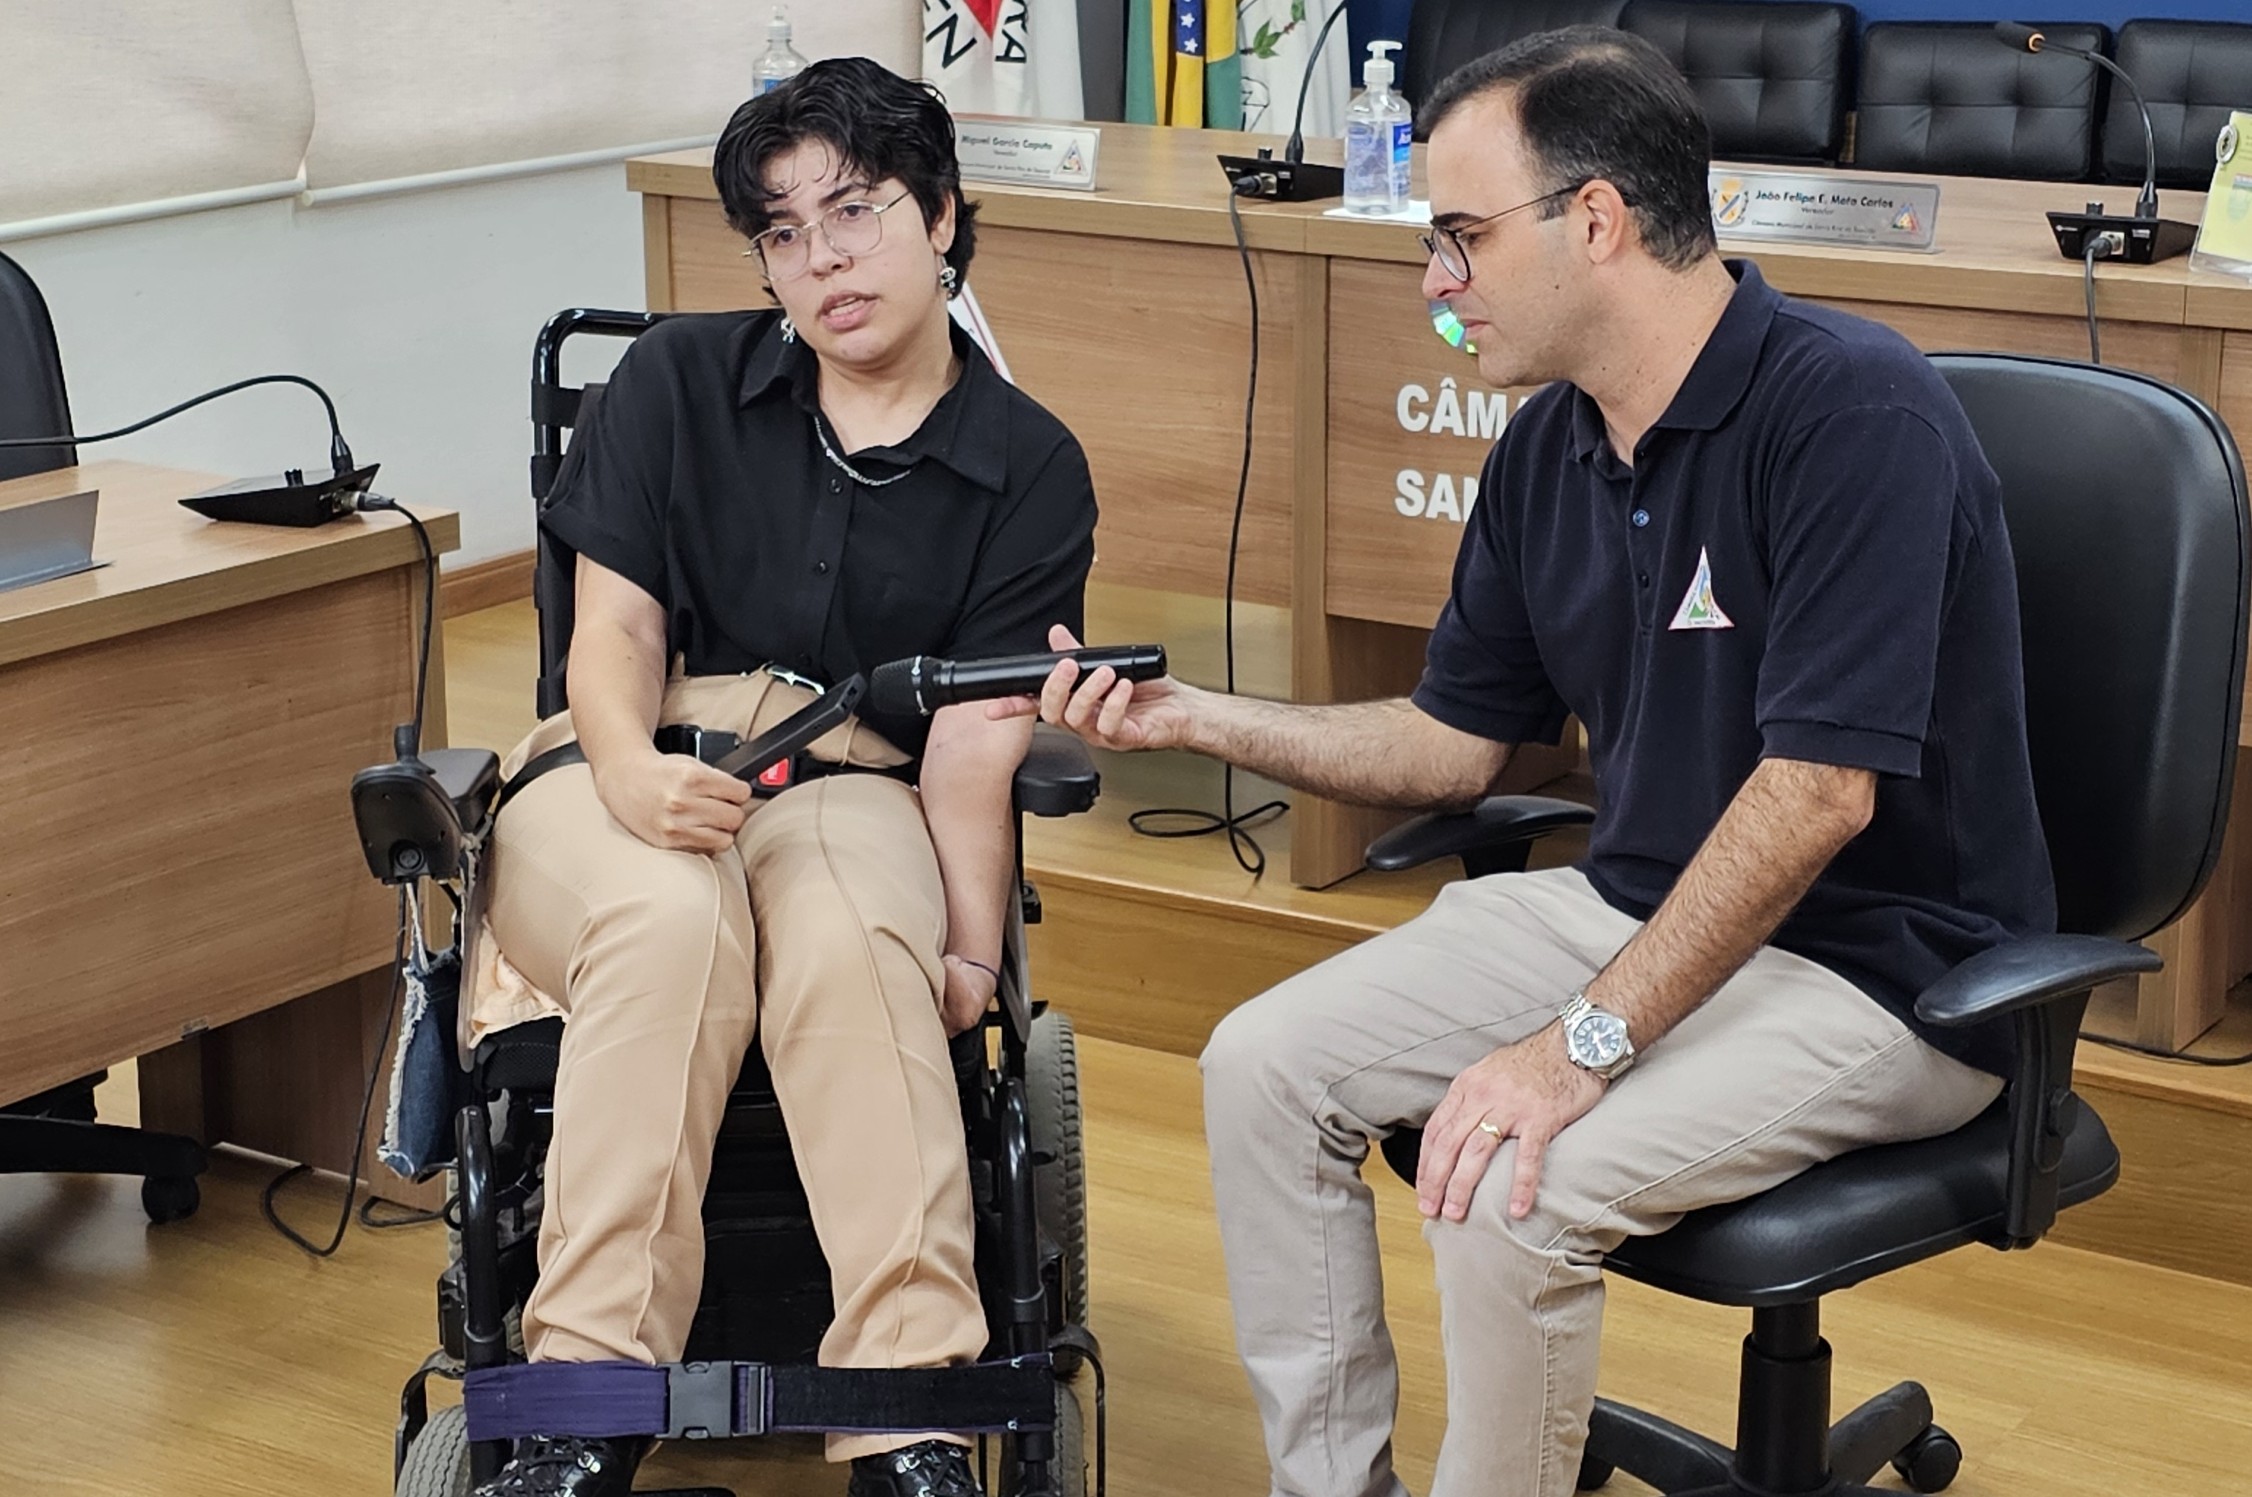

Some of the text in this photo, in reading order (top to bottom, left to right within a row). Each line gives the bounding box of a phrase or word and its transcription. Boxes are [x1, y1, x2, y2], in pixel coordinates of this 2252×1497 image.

[1755, 190, 1781, 200] João
[1783, 191, 1815, 204] Felipe
[1860, 196, 1894, 209] Carlos
[1397, 377, 1529, 440] CÂM
